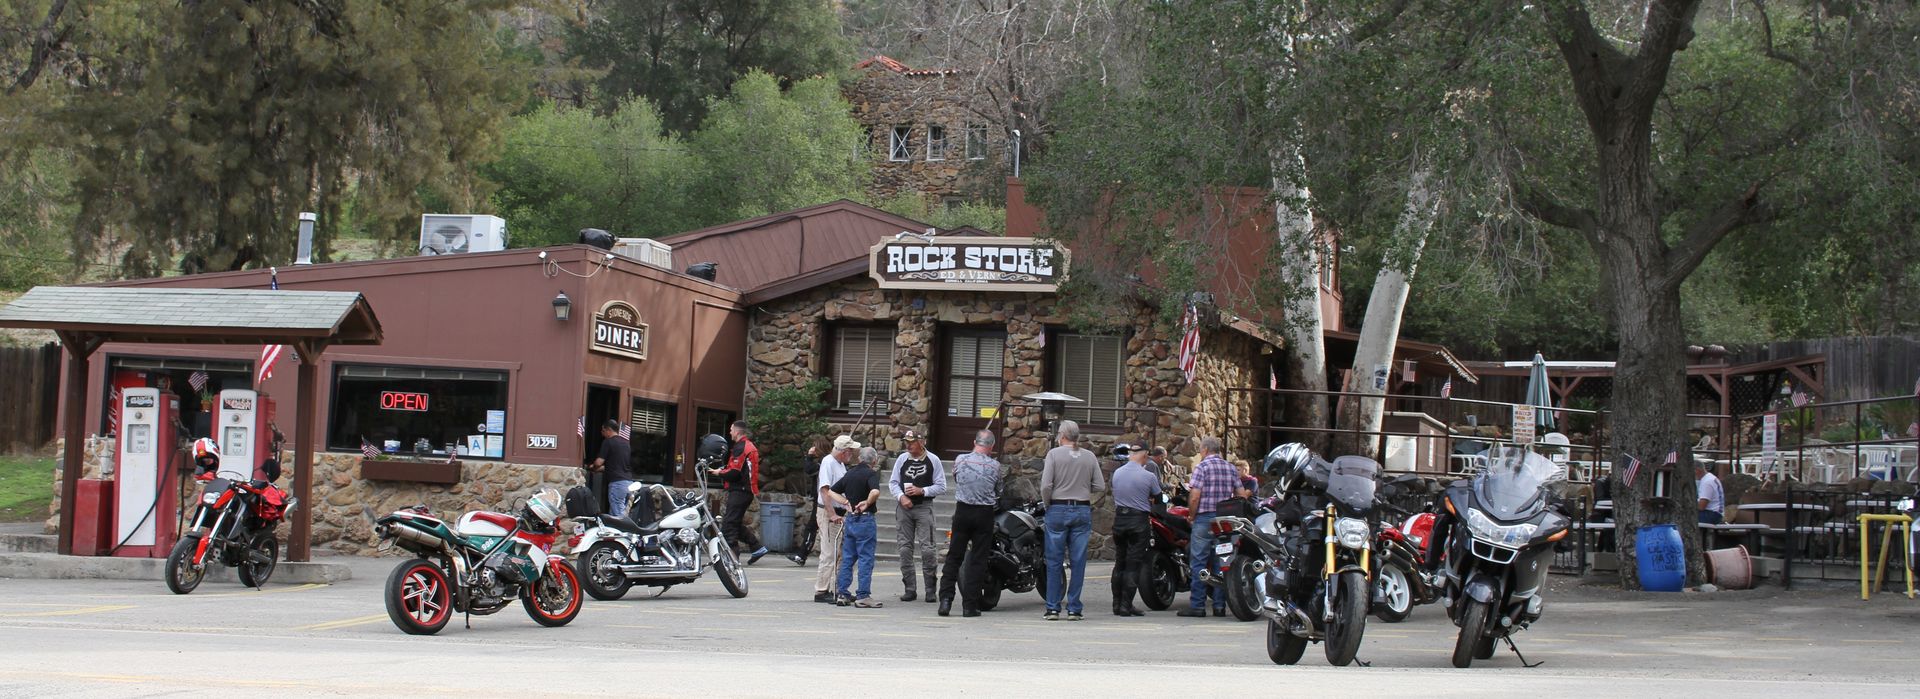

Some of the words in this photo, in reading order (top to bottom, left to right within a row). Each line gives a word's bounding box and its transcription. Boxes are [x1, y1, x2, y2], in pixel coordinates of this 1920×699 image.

[887, 246, 956, 272] ROCK
[965, 247, 1053, 275] STORE
[940, 271, 956, 279] ED
[968, 270, 995, 279] VERN
[608, 308, 632, 323] STONESIDE
[597, 324, 640, 348] DINER
[382, 393, 426, 410] OPEN
[472, 439, 481, 450] A
